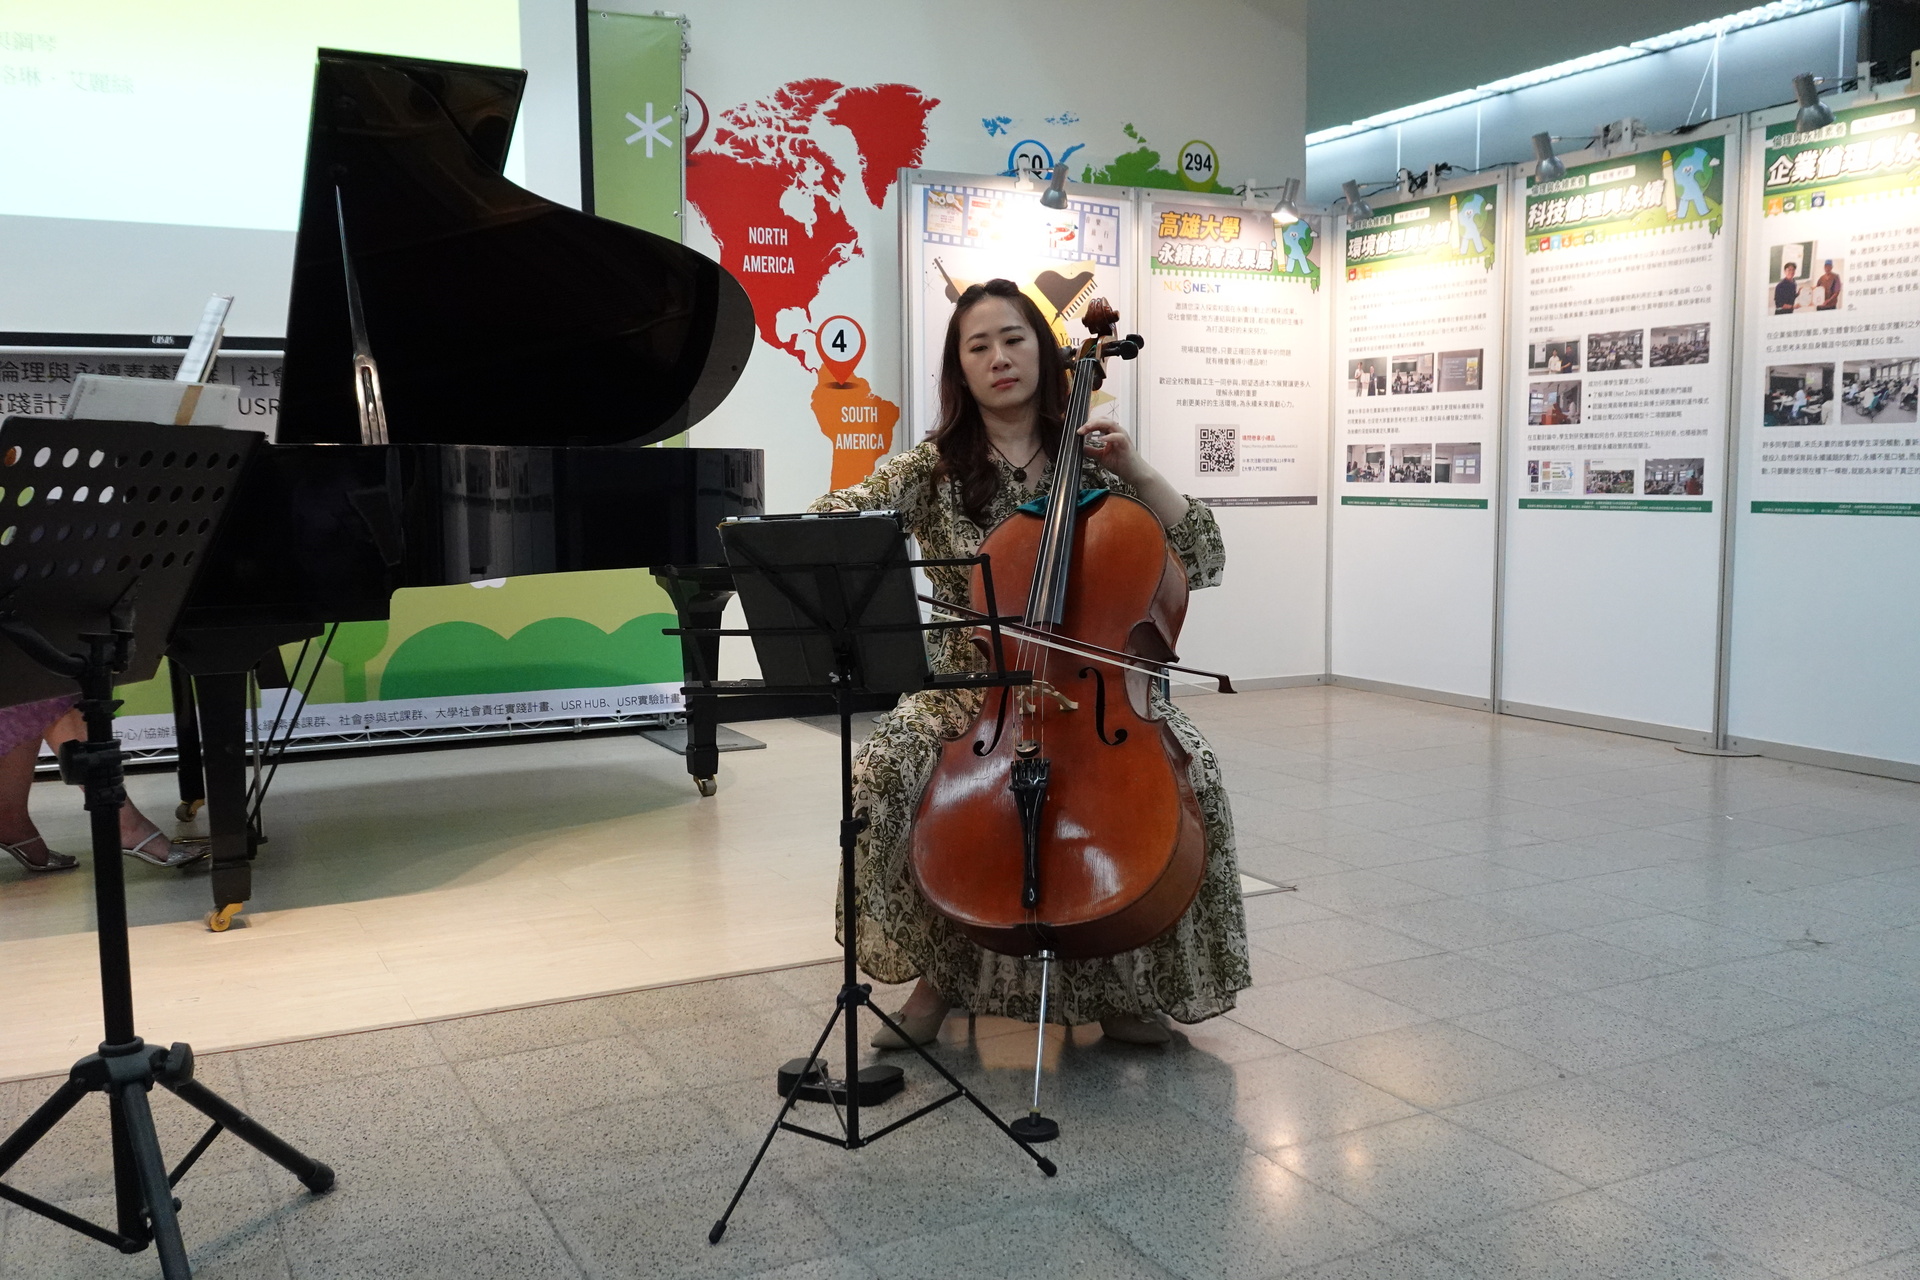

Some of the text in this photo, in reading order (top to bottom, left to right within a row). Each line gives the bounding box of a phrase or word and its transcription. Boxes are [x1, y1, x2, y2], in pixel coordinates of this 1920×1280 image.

[1184, 152, 1213, 172] 294
[1767, 132, 1920, 187] 企業倫理與永
[1528, 179, 1667, 229] 科技倫理與永續
[748, 226, 788, 246] NORTH
[1159, 211, 1241, 242] 高雄大學
[1347, 220, 1452, 260] 環境倫理與永續
[743, 255, 795, 274] AMERICA
[1158, 242, 1274, 271] 永續教育成果展
[831, 329, 847, 353] 4
[0, 393, 70, 415] 踐計
[841, 406, 878, 423] SOUTH
[835, 433, 885, 450] AMERICA
